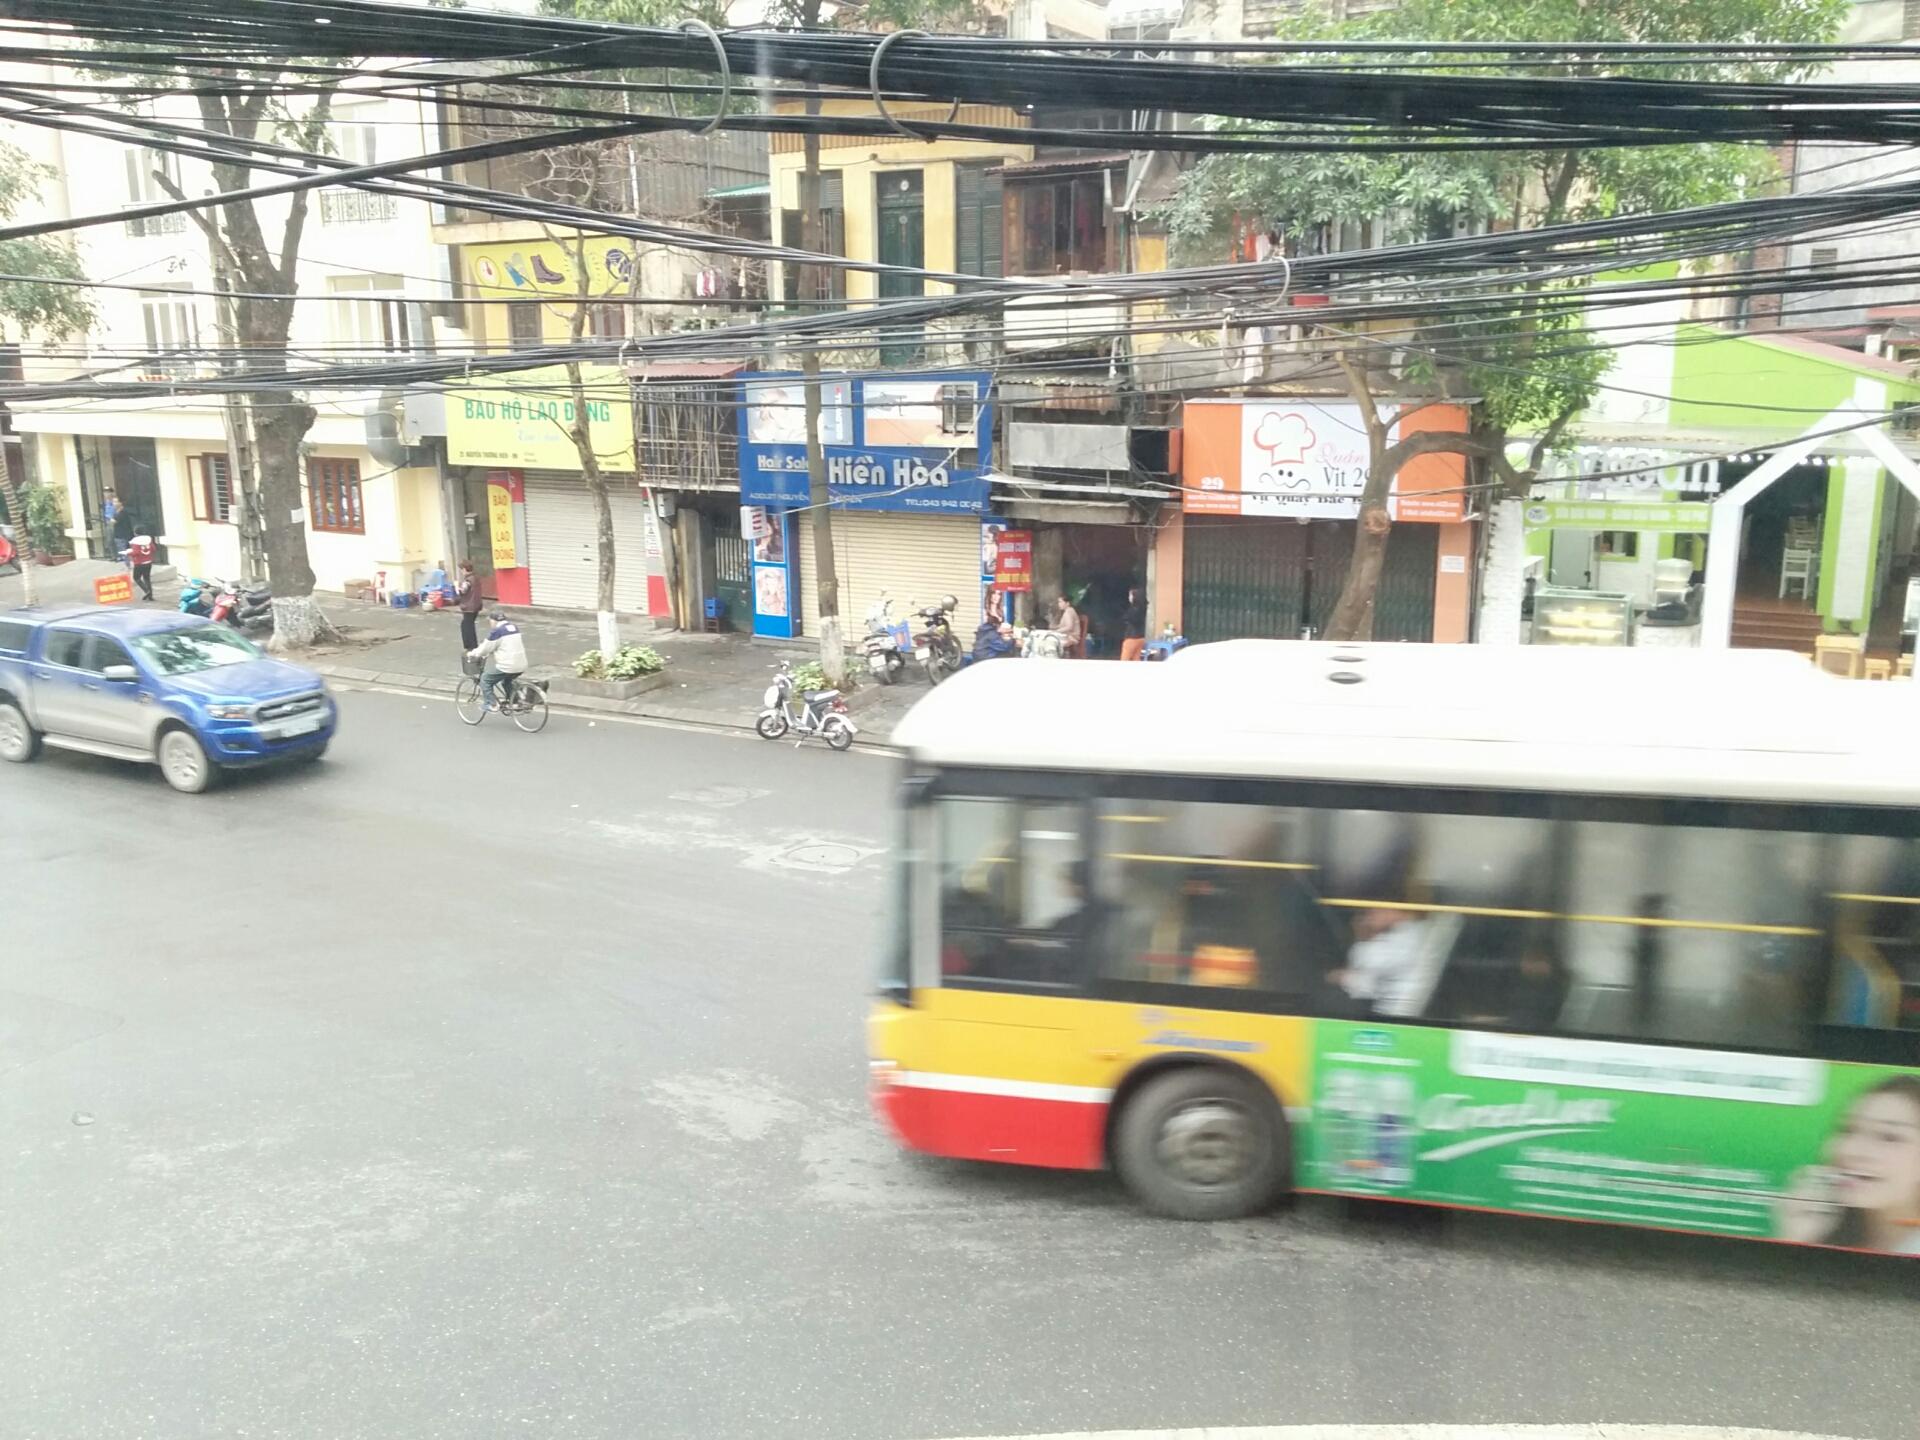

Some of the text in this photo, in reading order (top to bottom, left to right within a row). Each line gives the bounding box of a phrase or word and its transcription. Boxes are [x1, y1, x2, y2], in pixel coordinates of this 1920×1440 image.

[528, 402, 558, 421] LAO
[565, 402, 610, 422] ĐNG
[757, 454, 783, 470] Hair
[828, 455, 949, 488] Hiền Hòa
[1323, 466, 1346, 492] Vịt
